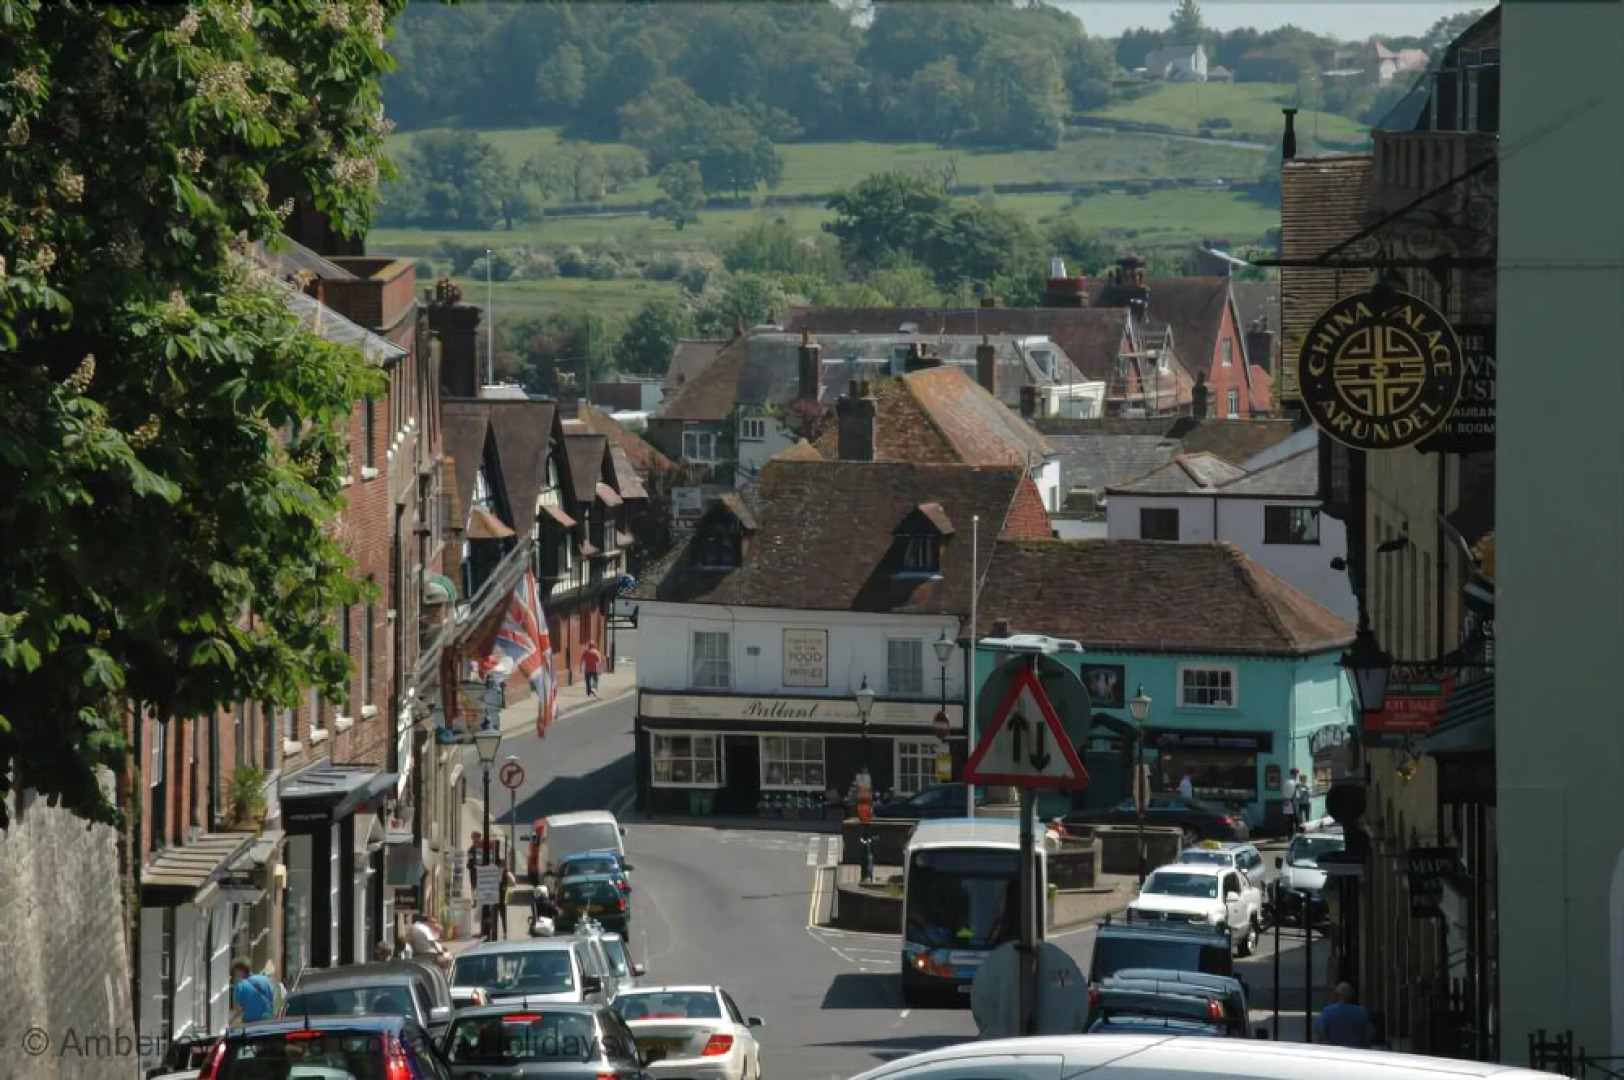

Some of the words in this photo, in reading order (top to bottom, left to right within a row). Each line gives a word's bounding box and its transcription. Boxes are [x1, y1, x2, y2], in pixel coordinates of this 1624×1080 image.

[1308, 301, 1372, 376] CHINA
[1381, 305, 1453, 378] ALACE
[1317, 400, 1441, 442] ARUNDEL
